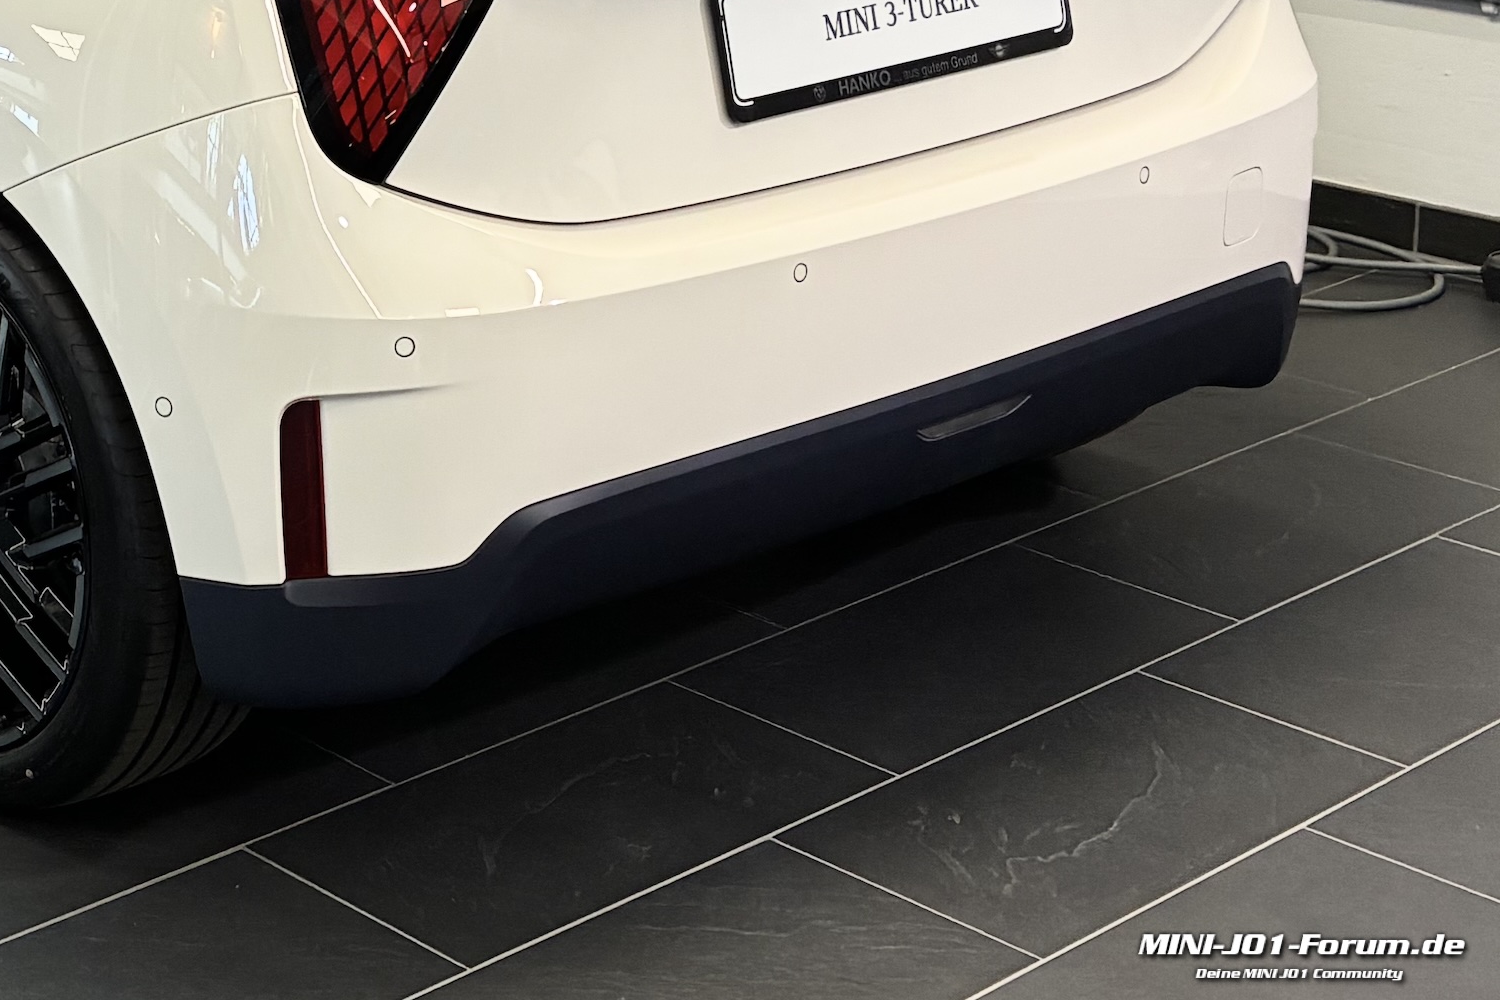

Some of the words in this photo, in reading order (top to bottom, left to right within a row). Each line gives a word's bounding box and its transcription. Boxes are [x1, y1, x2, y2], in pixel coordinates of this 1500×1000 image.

[822, 3, 881, 42] MINI
[838, 70, 891, 97] HANKO
[950, 52, 978, 69] Grund
